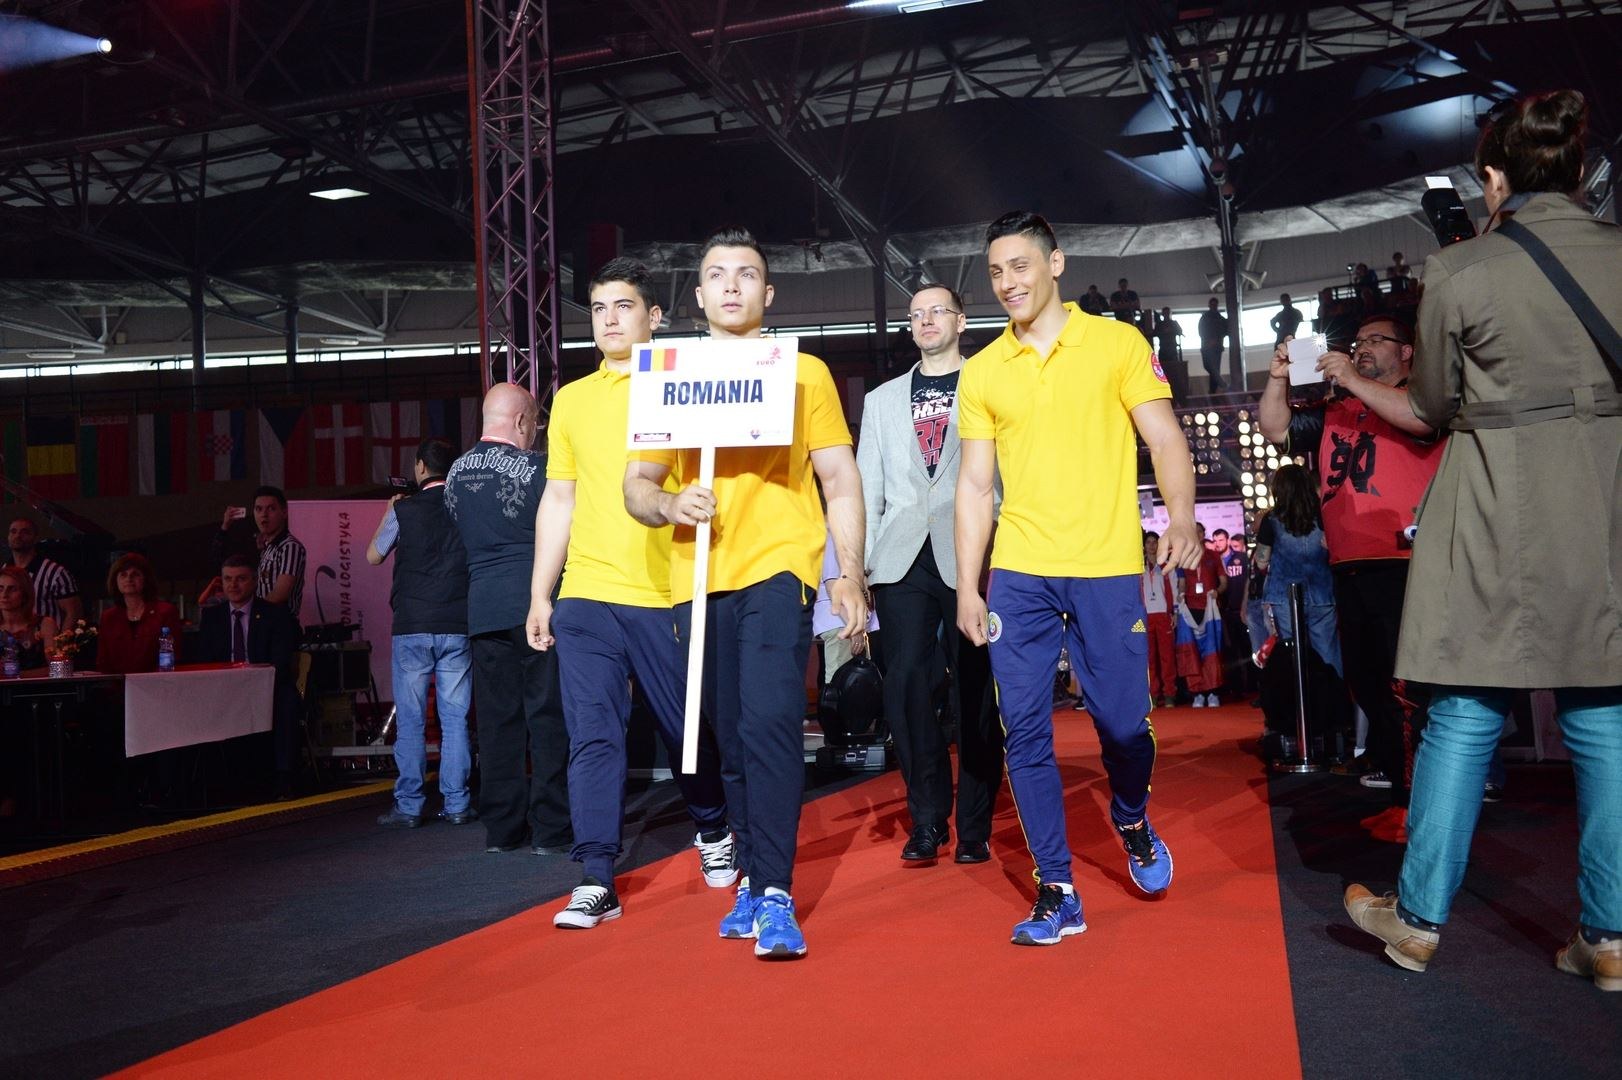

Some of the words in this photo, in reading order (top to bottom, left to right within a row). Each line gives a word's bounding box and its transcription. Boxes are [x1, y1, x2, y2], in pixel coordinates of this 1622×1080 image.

[663, 379, 763, 406] ROMANIA
[1327, 431, 1376, 493] 90
[339, 511, 352, 588] LOGISTYKA
